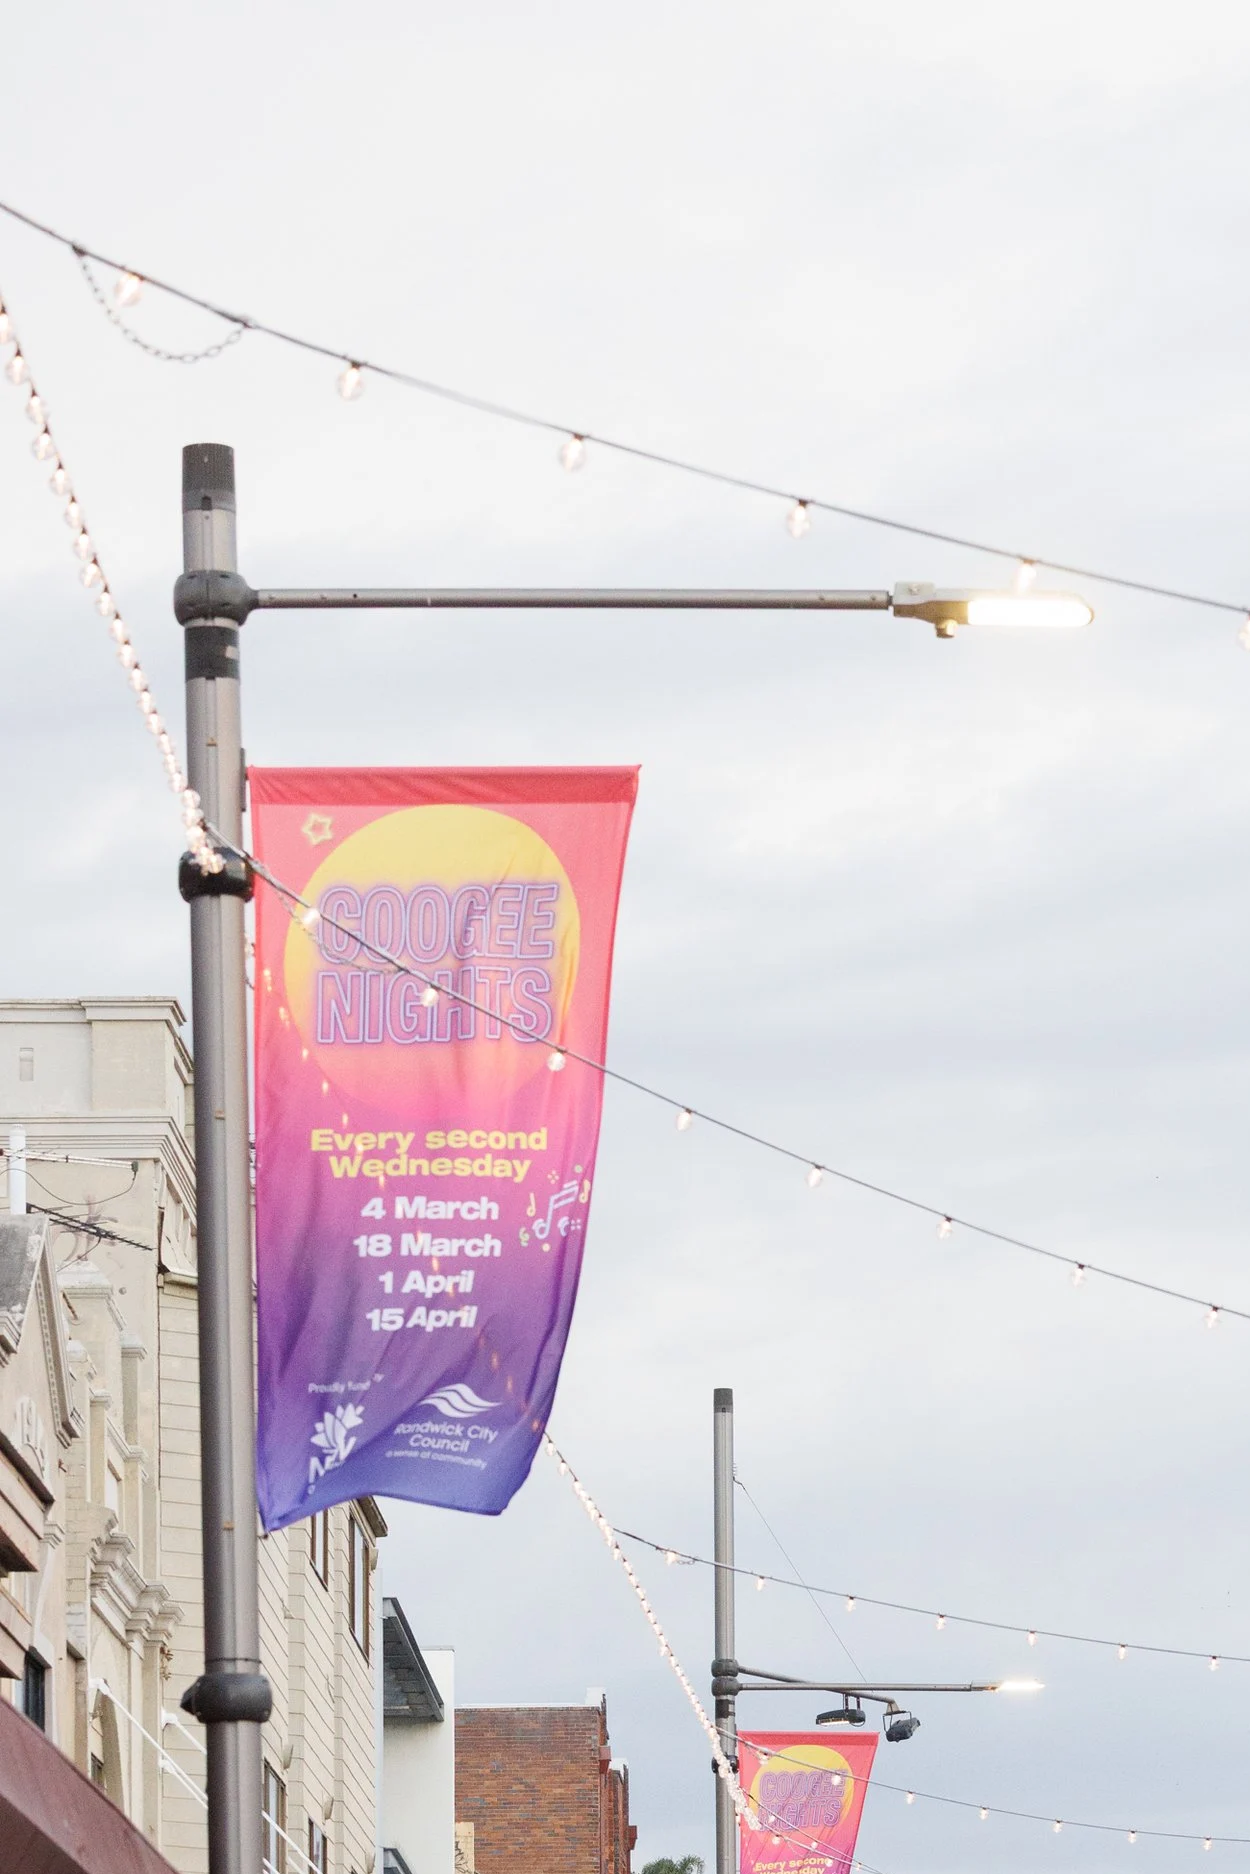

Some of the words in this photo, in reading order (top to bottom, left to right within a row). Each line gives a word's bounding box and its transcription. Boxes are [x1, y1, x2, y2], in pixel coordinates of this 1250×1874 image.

[318, 883, 558, 963] COOGEE
[317, 966, 551, 1043] NIGHTS
[311, 1128, 415, 1153] Every
[425, 1127, 548, 1150] second
[329, 1153, 531, 1183] Wednesday
[360, 1197, 386, 1220] 4
[394, 1195, 500, 1220] March
[353, 1233, 393, 1258] 18
[400, 1232, 502, 1257] March
[379, 1271, 394, 1294] 1
[402, 1270, 475, 1298] April
[365, 1308, 404, 1331] 15
[406, 1305, 478, 1332] April
[408, 1434, 470, 1453] Council
[467, 1425, 498, 1444] City
[760, 1769, 848, 1802] COOGEE
